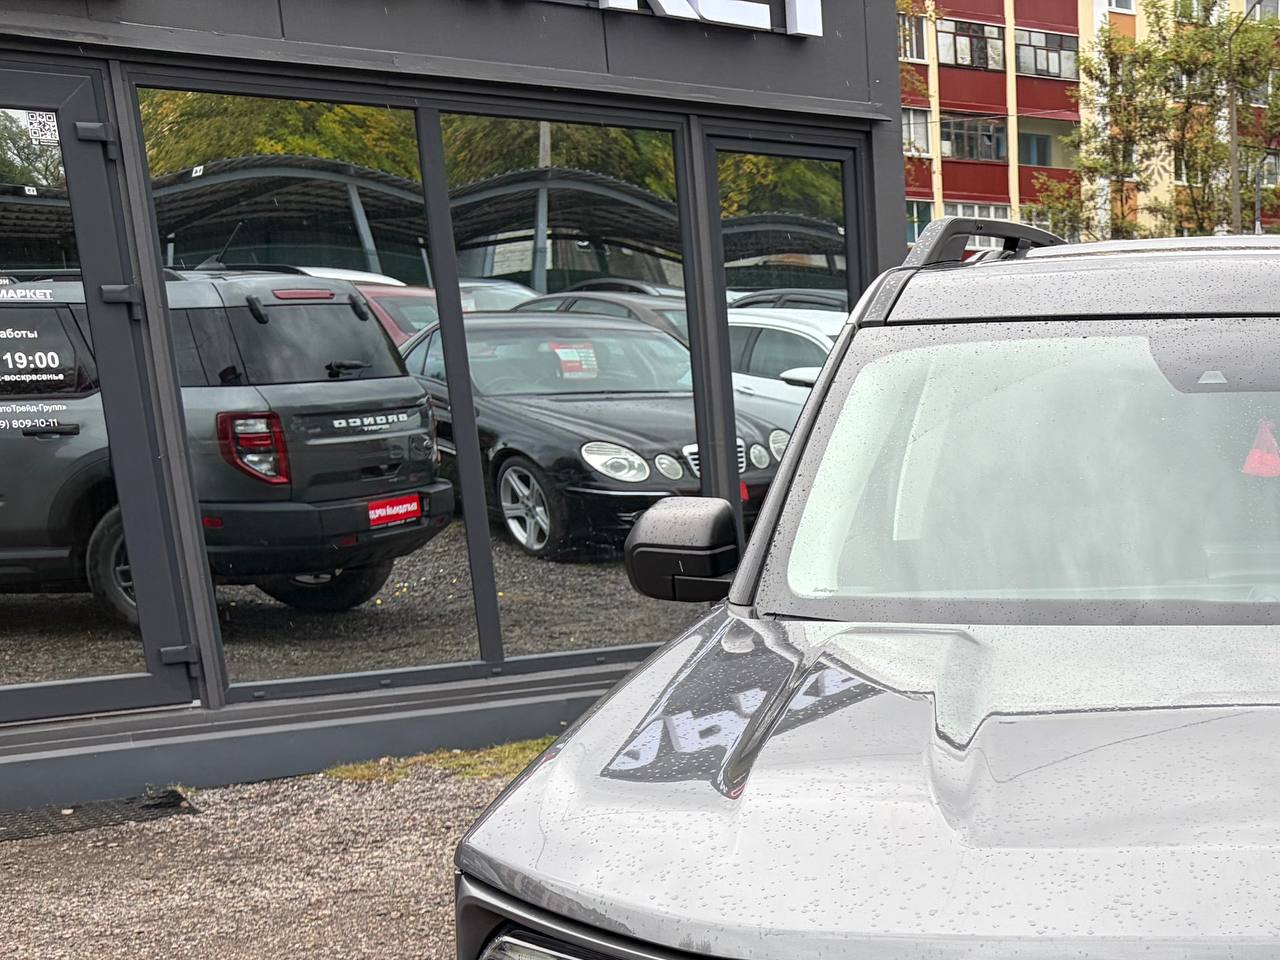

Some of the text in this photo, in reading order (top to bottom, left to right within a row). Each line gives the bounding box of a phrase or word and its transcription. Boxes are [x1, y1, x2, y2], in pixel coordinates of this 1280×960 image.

[0, 328, 38, 338] аботы
[2, 351, 60, 369] 19:00
[12, 418, 59, 428] 809-10-11
